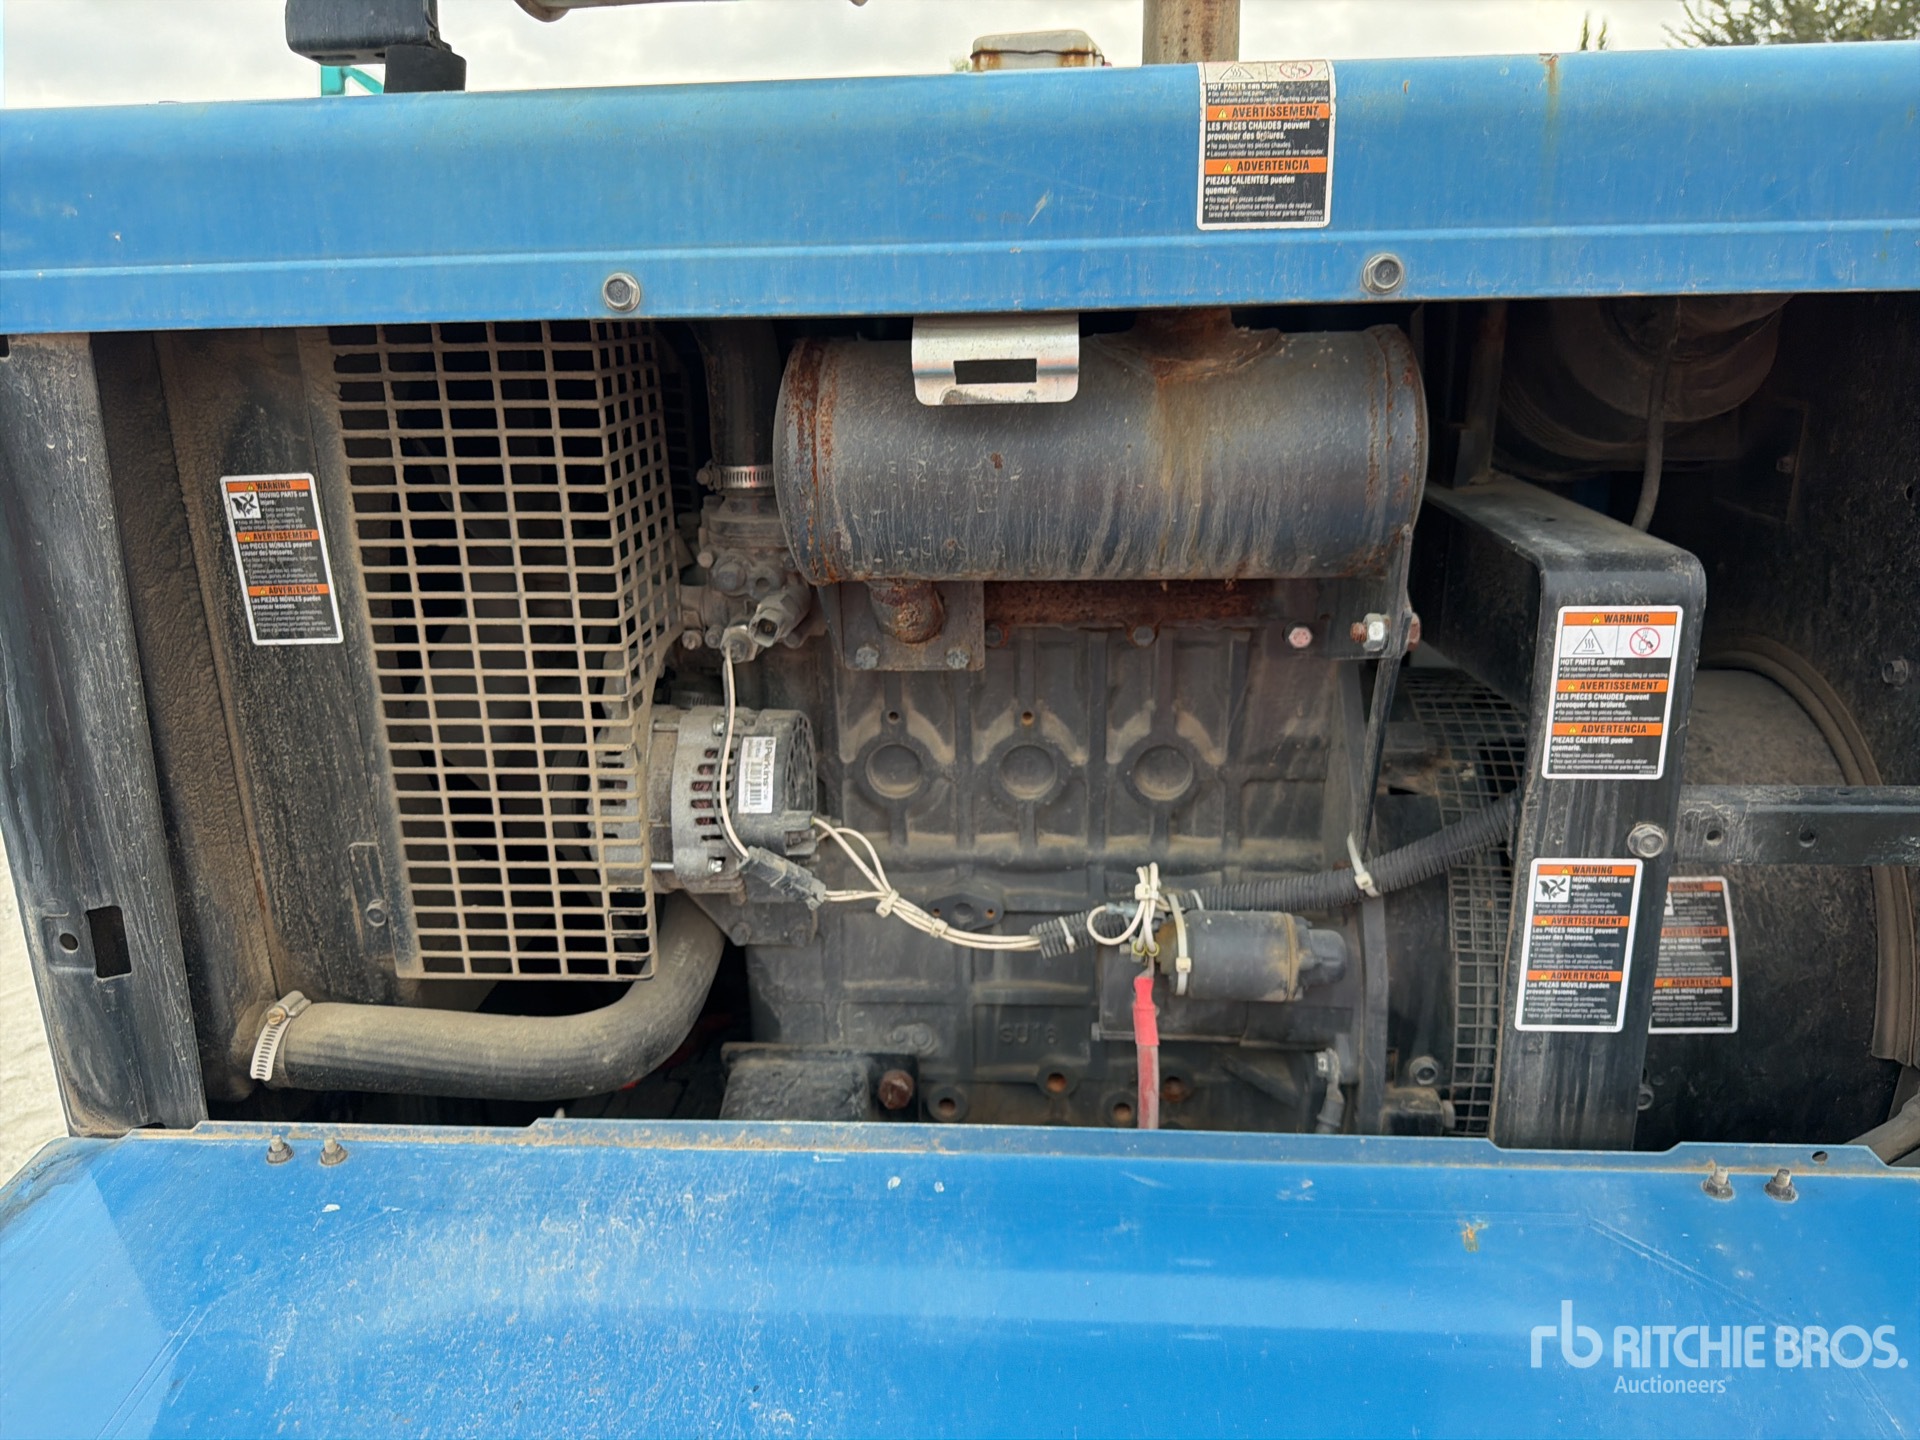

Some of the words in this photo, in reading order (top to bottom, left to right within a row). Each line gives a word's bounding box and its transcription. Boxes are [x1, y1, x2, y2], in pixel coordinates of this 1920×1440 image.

[1232, 106, 1319, 118] AVERTISSEMENT
[1208, 122, 1220, 131] LES
[1249, 121, 1281, 130] CHAUDES
[1284, 121, 1310, 130] peuvent
[1207, 132, 1241, 141] provoquer
[1243, 132, 1255, 141] des
[1237, 160, 1310, 172] ADVERTENCIA
[1206, 176, 1230, 186] PIEZAS
[1232, 175, 1269, 185] CALIENTES
[1270, 175, 1295, 185] pueden
[256, 481, 291, 490] WARNING
[253, 532, 313, 540] AVERTISSEMENT
[268, 586, 319, 594] ADVERTENCIA
[1604, 614, 1649, 623] WARNING
[1580, 681, 1659, 690] AVERTISSEMENT
[1581, 725, 1647, 733] ADVERTENCIA
[1672, 978, 1722, 986] ADVERTENCIA
